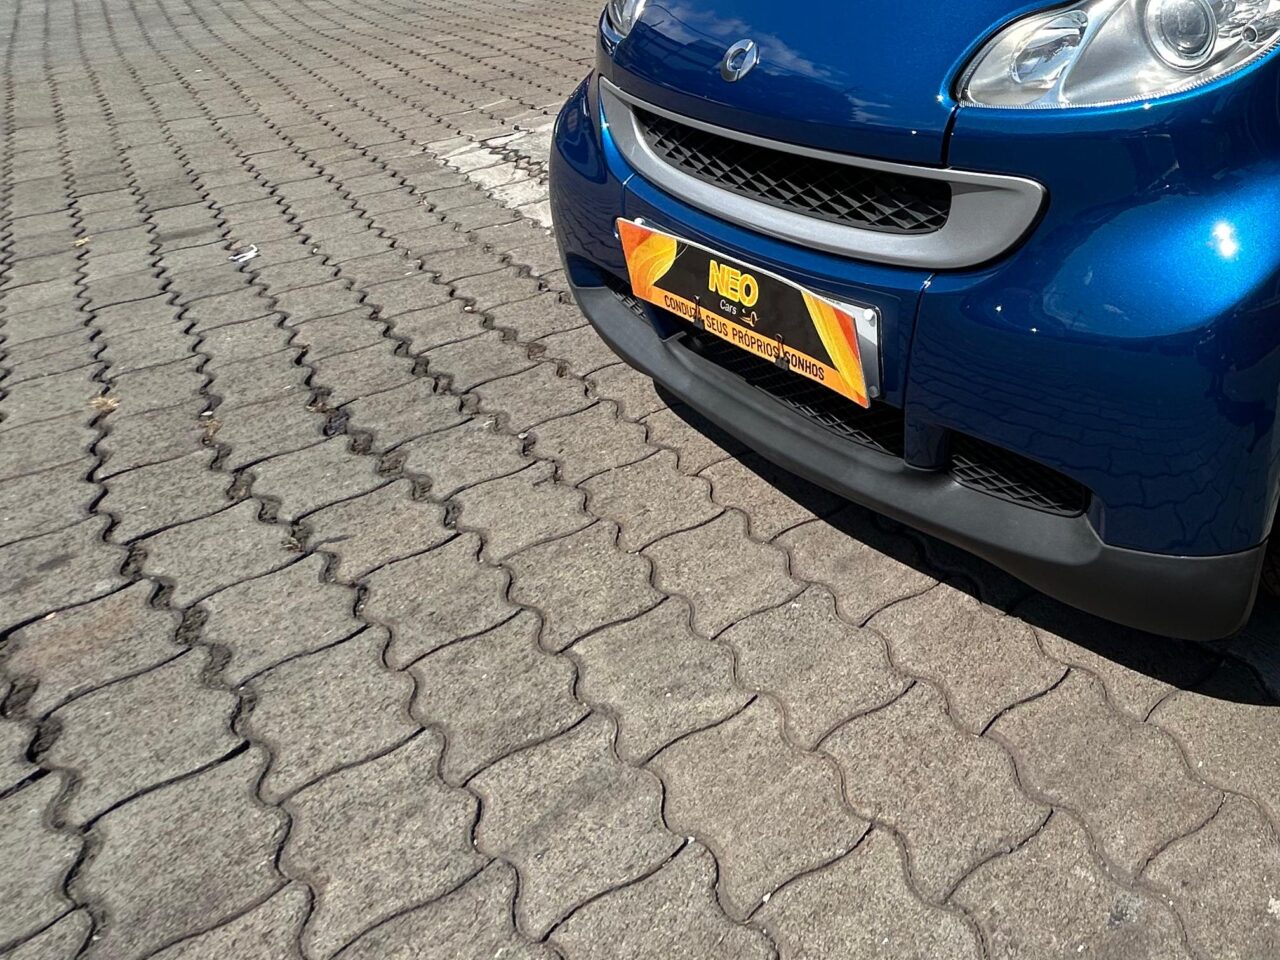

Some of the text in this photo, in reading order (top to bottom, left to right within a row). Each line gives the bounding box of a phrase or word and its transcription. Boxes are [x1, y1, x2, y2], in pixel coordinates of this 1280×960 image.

[708, 259, 759, 308] NEO
[720, 299, 737, 315] Cars
[705, 315, 728, 337] SEUS
[732, 328, 779, 359] PRÓPRIOS
[784, 351, 825, 381] SONHOS
